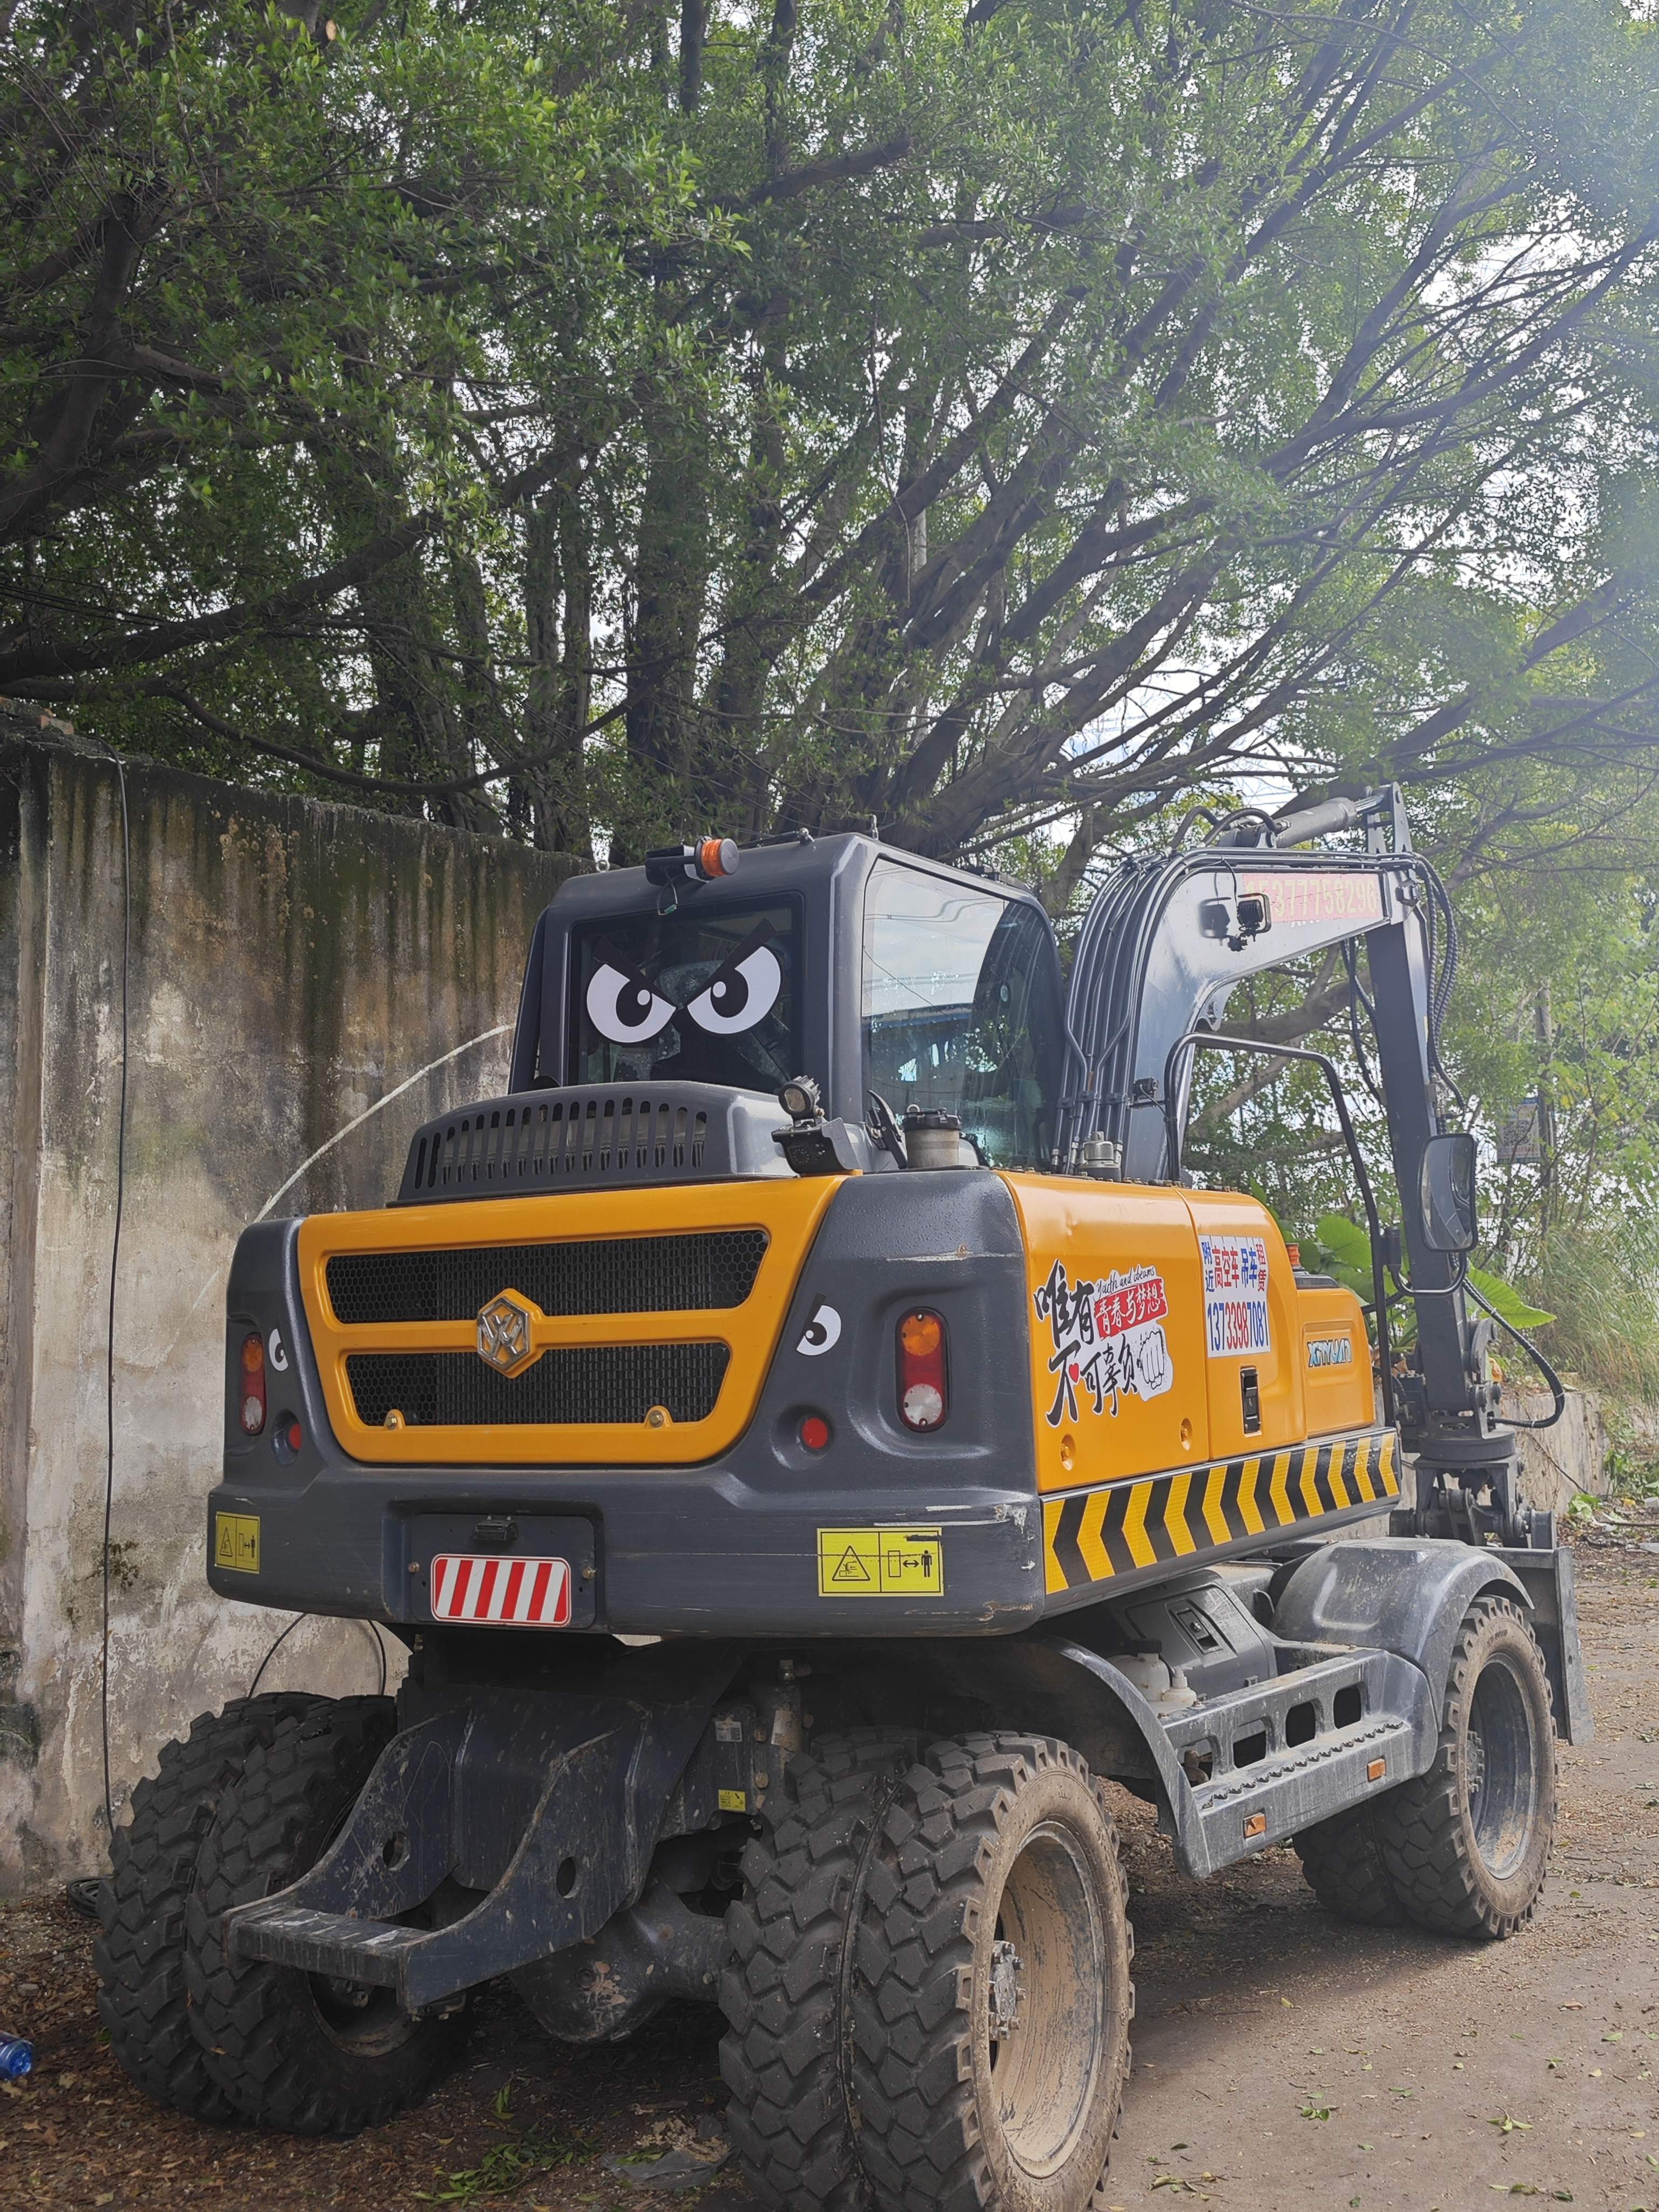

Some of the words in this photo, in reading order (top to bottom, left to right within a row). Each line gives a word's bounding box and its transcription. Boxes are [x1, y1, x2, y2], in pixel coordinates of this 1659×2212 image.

[1120, 1267, 1132, 1286] and
[1134, 1265, 1155, 1281] dreams
[1202, 1241, 1215, 1292] 附近
[1212, 1245, 1239, 1289] 高空车
[1240, 1246, 1257, 1289] 吊车
[1256, 1243, 1266, 1292] 租赁
[1033, 1259, 1095, 1349] 唯有
[1095, 1283, 1161, 1335] 青春与梦想
[1208, 1300, 1269, 1351] 13733987081
[1046, 1334, 1138, 1426] 不可辜负
